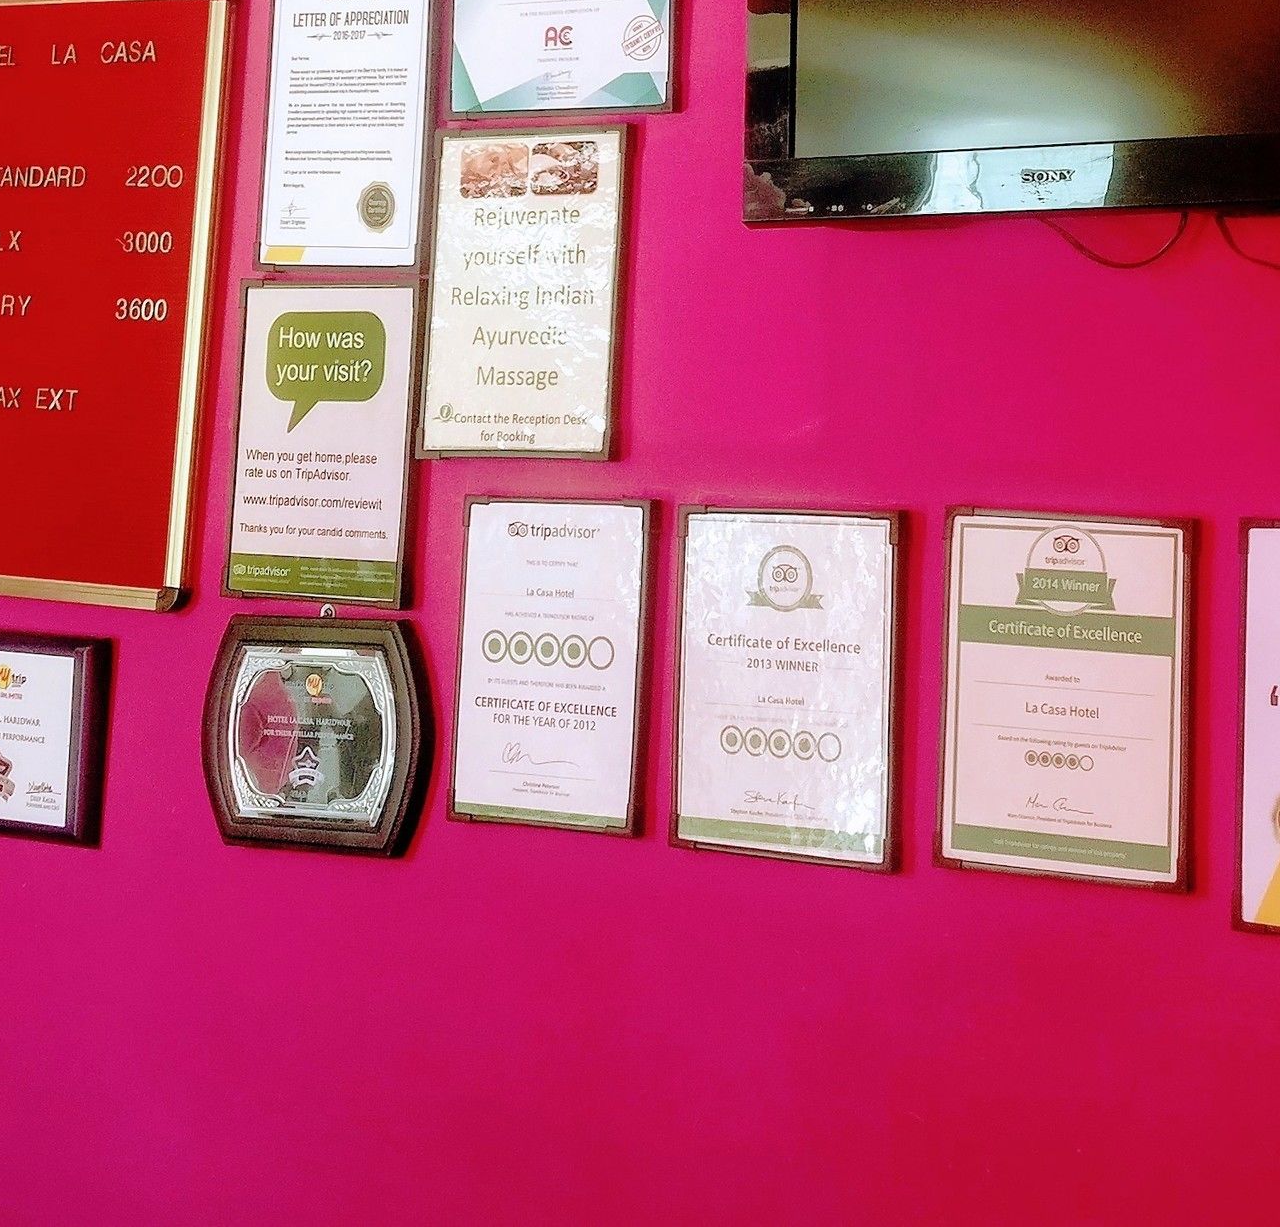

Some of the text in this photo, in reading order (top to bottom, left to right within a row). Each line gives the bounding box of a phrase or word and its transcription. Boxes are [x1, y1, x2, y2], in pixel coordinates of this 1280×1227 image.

[293, 9, 409, 28] LETTER OF APPRECIATION
[51, 44, 77, 65] LA
[100, 41, 157, 64] CASA
[125, 165, 183, 188] 2200
[1021, 170, 1075, 184] SONY
[122, 231, 173, 253] 3000
[115, 297, 168, 322] 3600
[278, 326, 365, 349] How was
[276, 360, 373, 386] your visit?
[36, 388, 79, 411] EXT
[243, 493, 382, 512] www.tripadvisor.com/reviewit
[1032, 577, 1100, 593] 2014 Winner
[988, 619, 1143, 644] Certificate of Excellence
[707, 633, 861, 654] Certificate of Excellence
[747, 658, 819, 673] 2013 WINNER
[475, 696, 617, 717] CERTIFICATE OF EXCELLENCE
[1025, 702, 1099, 719] La Casa Hotel
